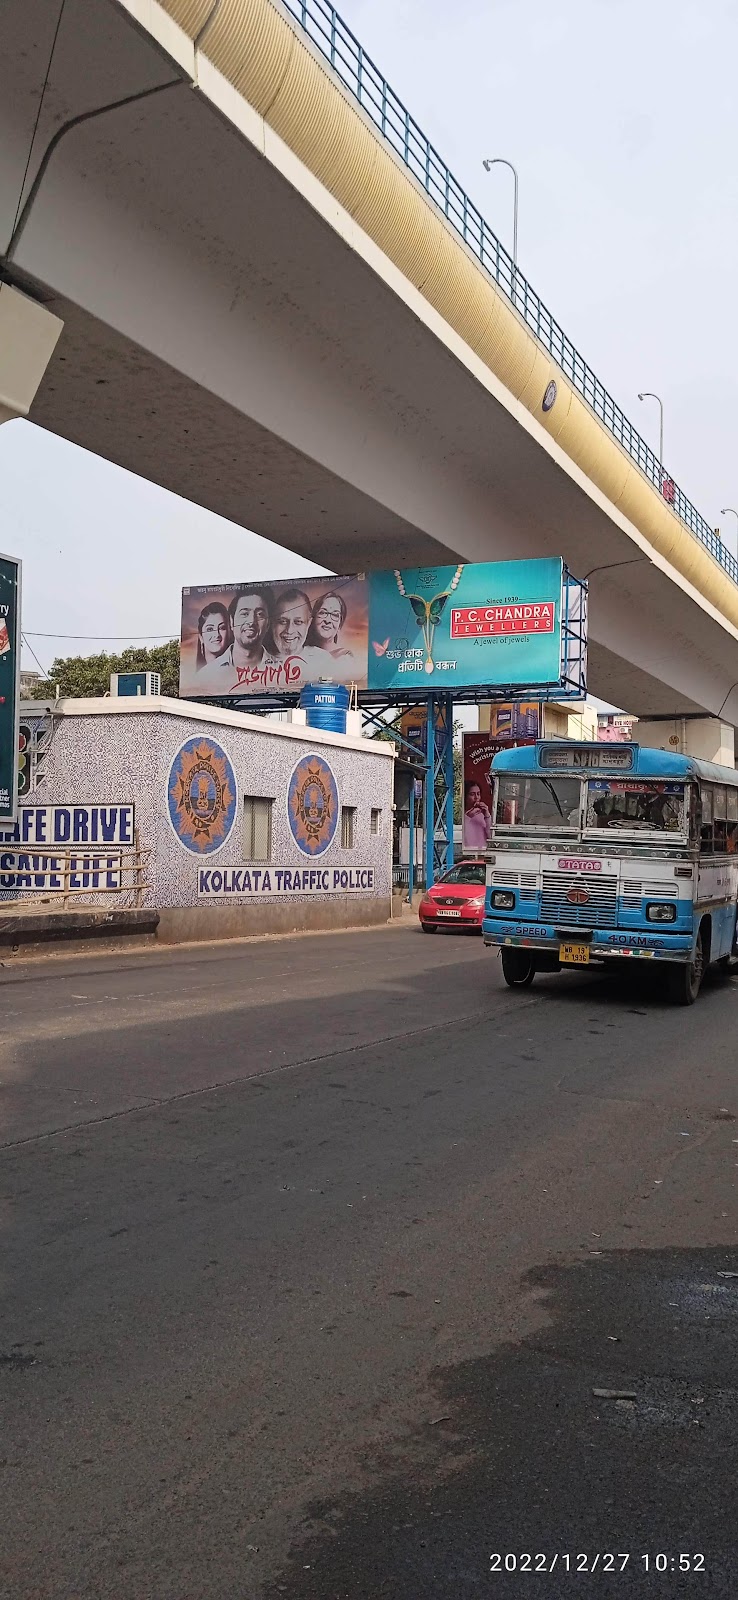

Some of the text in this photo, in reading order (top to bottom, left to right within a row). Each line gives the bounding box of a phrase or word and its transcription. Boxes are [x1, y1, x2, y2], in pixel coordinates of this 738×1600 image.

[454, 605, 551, 622] P. C. CHANDRA
[454, 620, 551, 633] JEWELLERS
[500, 636, 508, 644] of
[386, 648, 424, 659] শুভ হোক
[398, 659, 424, 673] প্রতিটি
[229, 655, 308, 692] প্রজাপতি
[314, 695, 336, 704] PATTON
[469, 747, 484, 759] Wish
[472, 752, 496, 765] Christm
[54, 807, 131, 842] DRIVE
[0, 853, 119, 888] SAVE LIFE
[565, 860, 594, 870] TATA
[199, 869, 373, 893] KOLKATA TRAFFIC POLICE
[515, 926, 547, 936] SPEED
